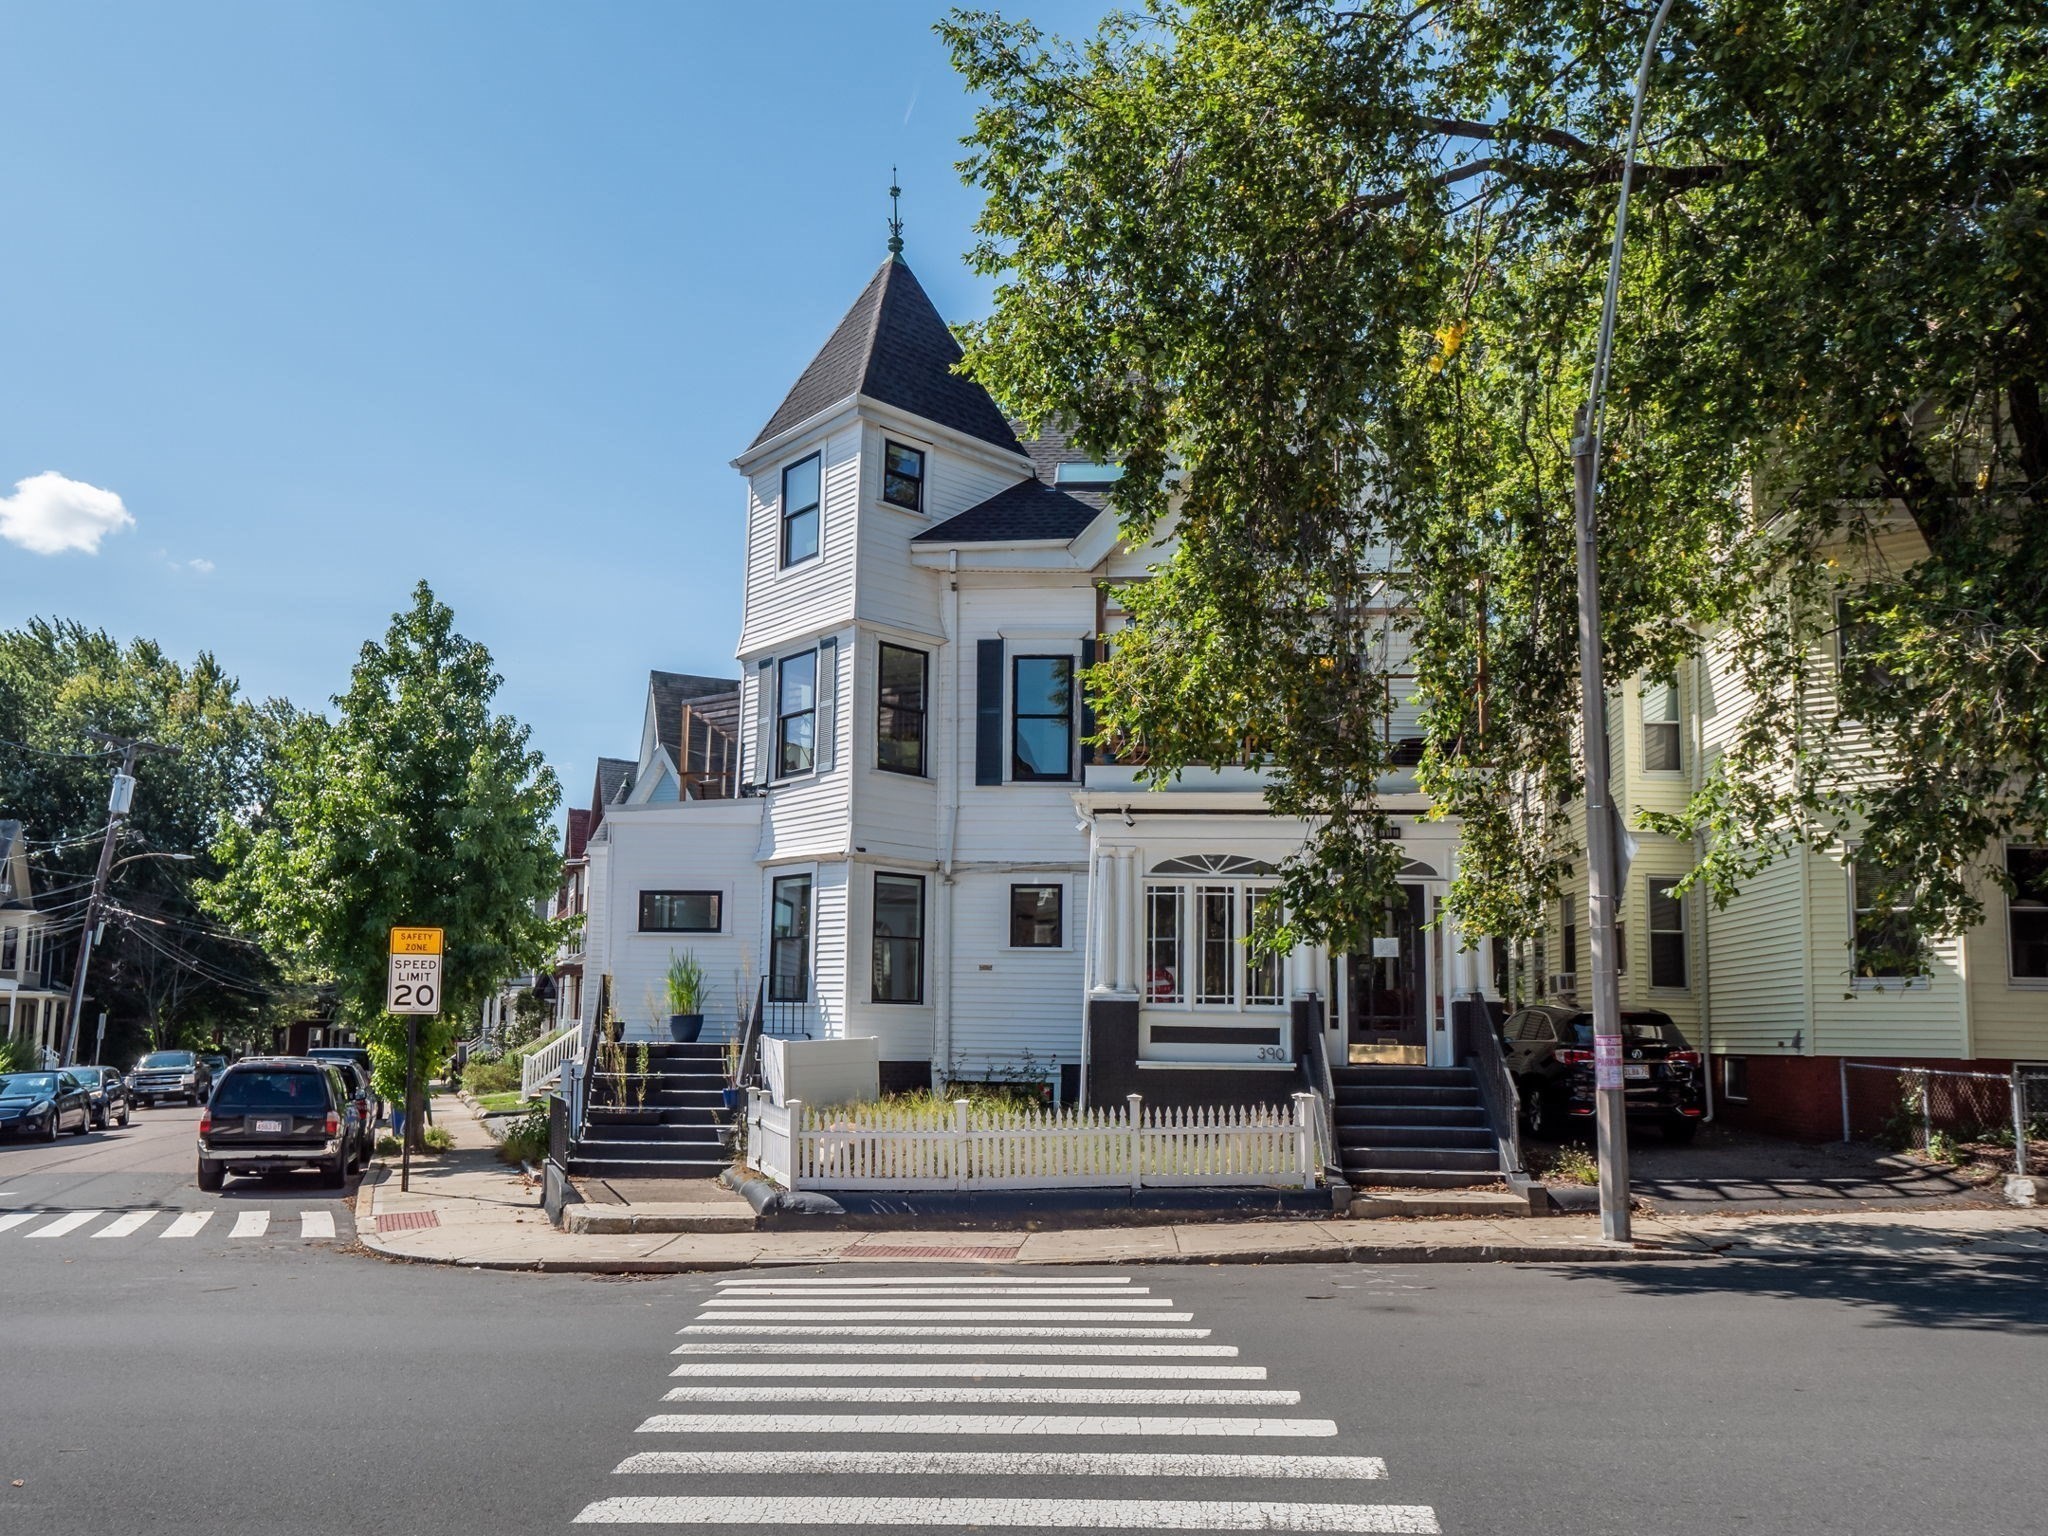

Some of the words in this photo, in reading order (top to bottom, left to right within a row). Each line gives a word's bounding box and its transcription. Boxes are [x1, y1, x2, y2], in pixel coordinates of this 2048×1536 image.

[400, 933, 433, 941] SAFETY
[405, 943, 428, 951] ZONE
[395, 960, 437, 970] SPEED
[398, 972, 432, 982] LIMIT
[393, 984, 434, 1007] 20
[1257, 1047, 1285, 1061] 390
